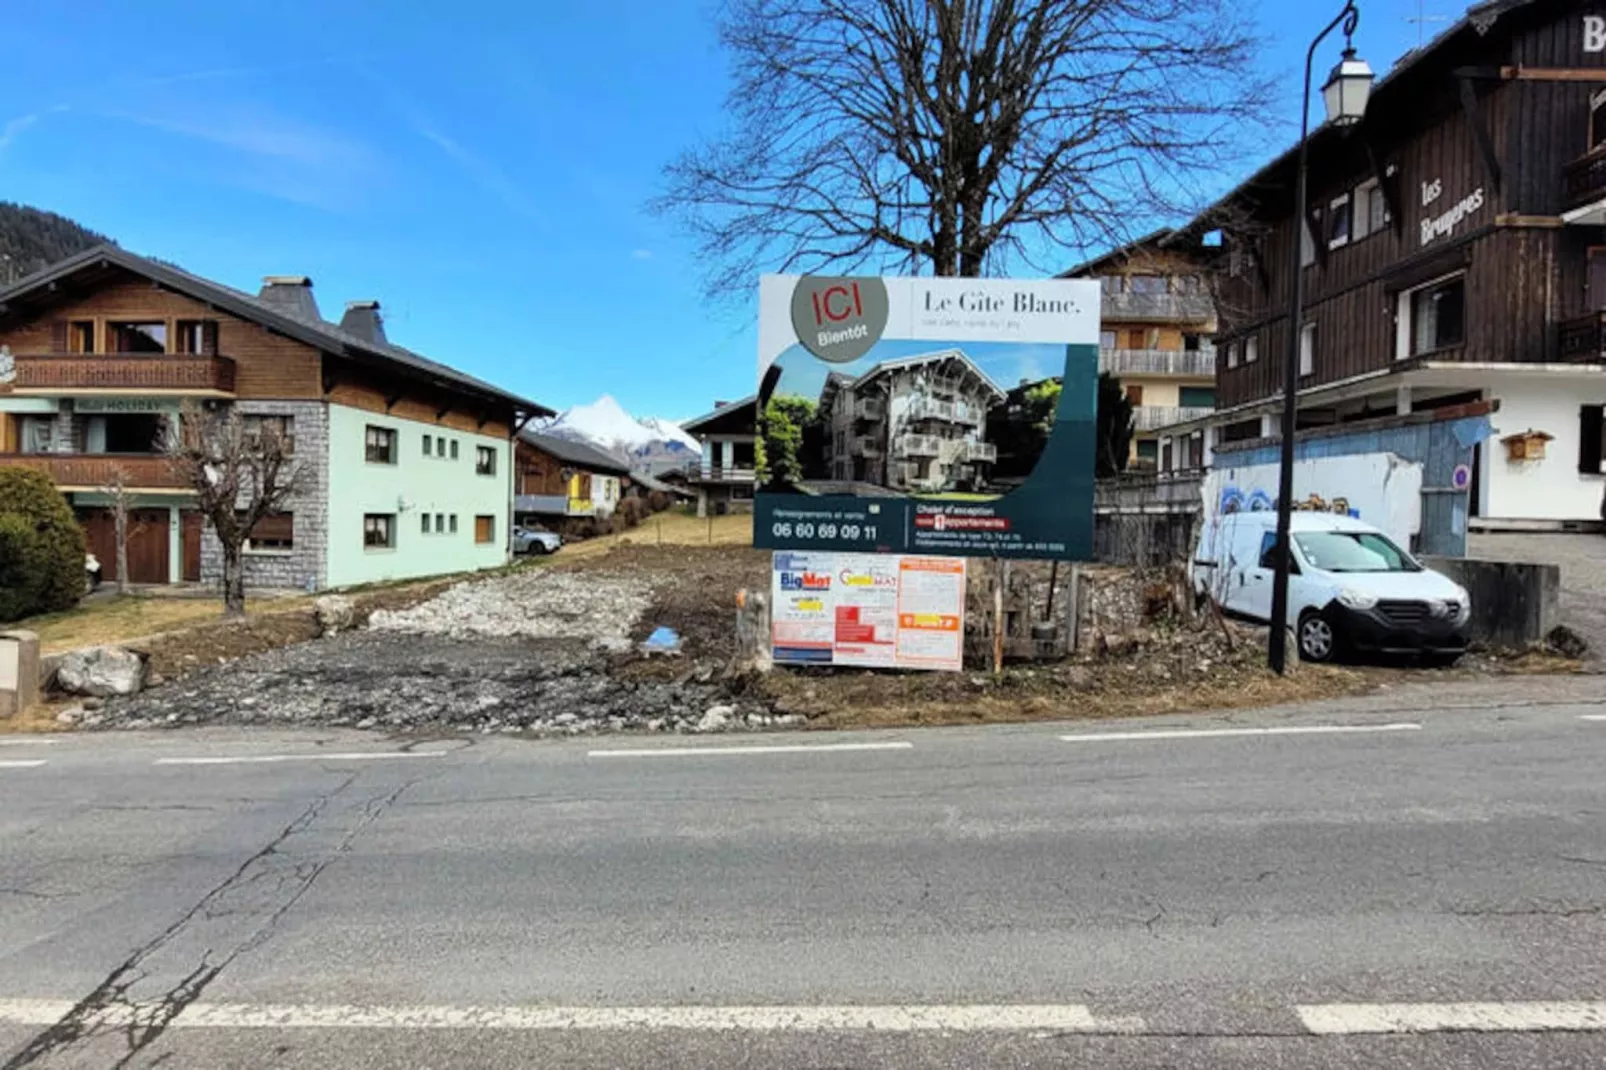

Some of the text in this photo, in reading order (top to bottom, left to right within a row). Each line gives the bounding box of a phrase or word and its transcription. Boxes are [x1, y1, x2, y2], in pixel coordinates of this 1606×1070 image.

[812, 281, 863, 325] ICI
[924, 290, 1082, 315] Le Gîte Blanc.
[816, 322, 869, 348] Bientôt
[916, 503, 995, 517] Chalet d'exception
[772, 522, 877, 541] 06 60 69 09 11
[780, 572, 832, 588] BigMat
